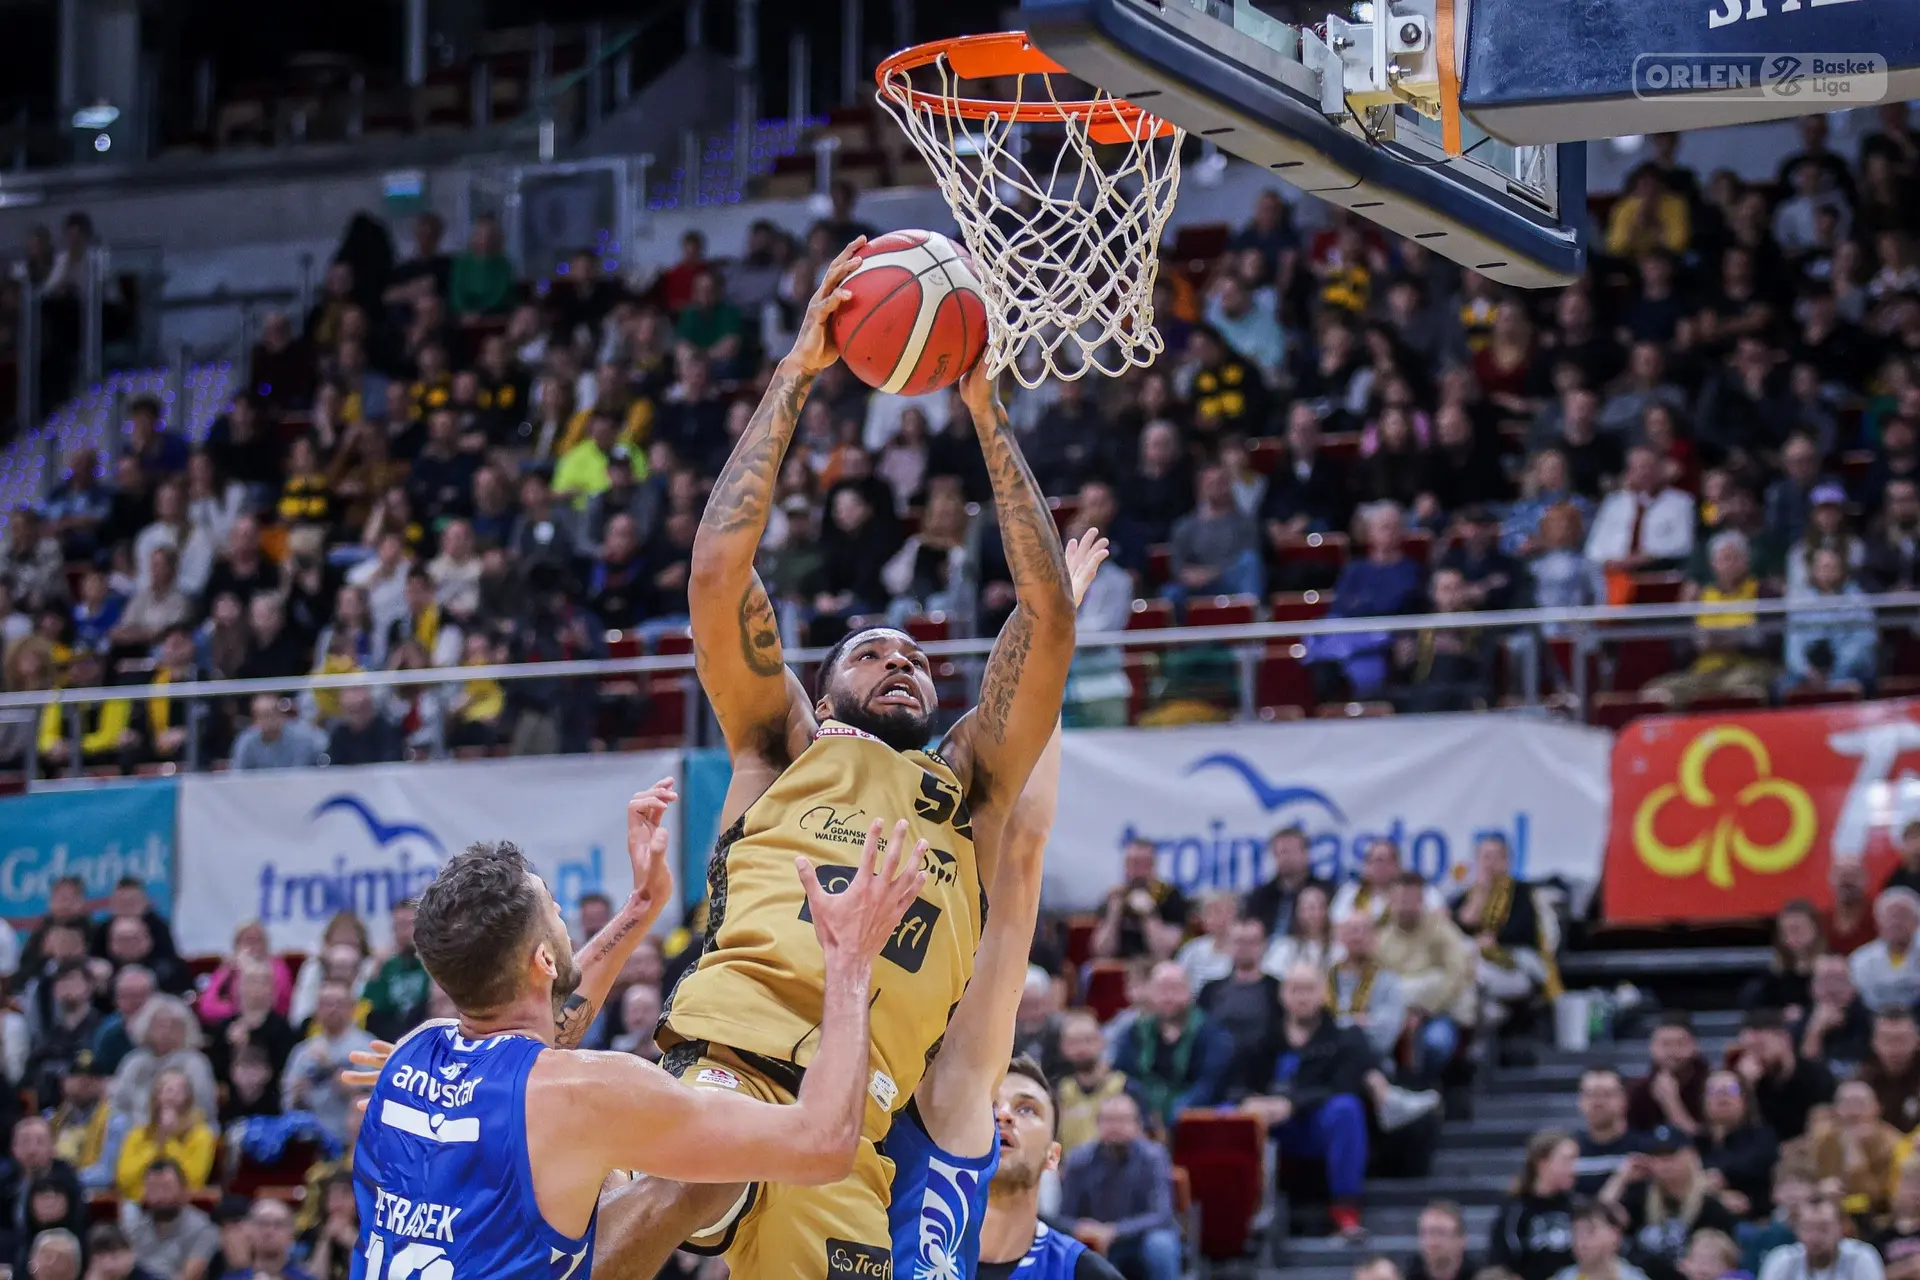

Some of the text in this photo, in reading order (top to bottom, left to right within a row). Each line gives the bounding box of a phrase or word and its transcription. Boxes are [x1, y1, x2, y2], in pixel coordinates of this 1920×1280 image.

[816, 727, 853, 738] ORLEN
[814, 832, 848, 843] WALESA
[830, 826, 867, 839] GDANSK
